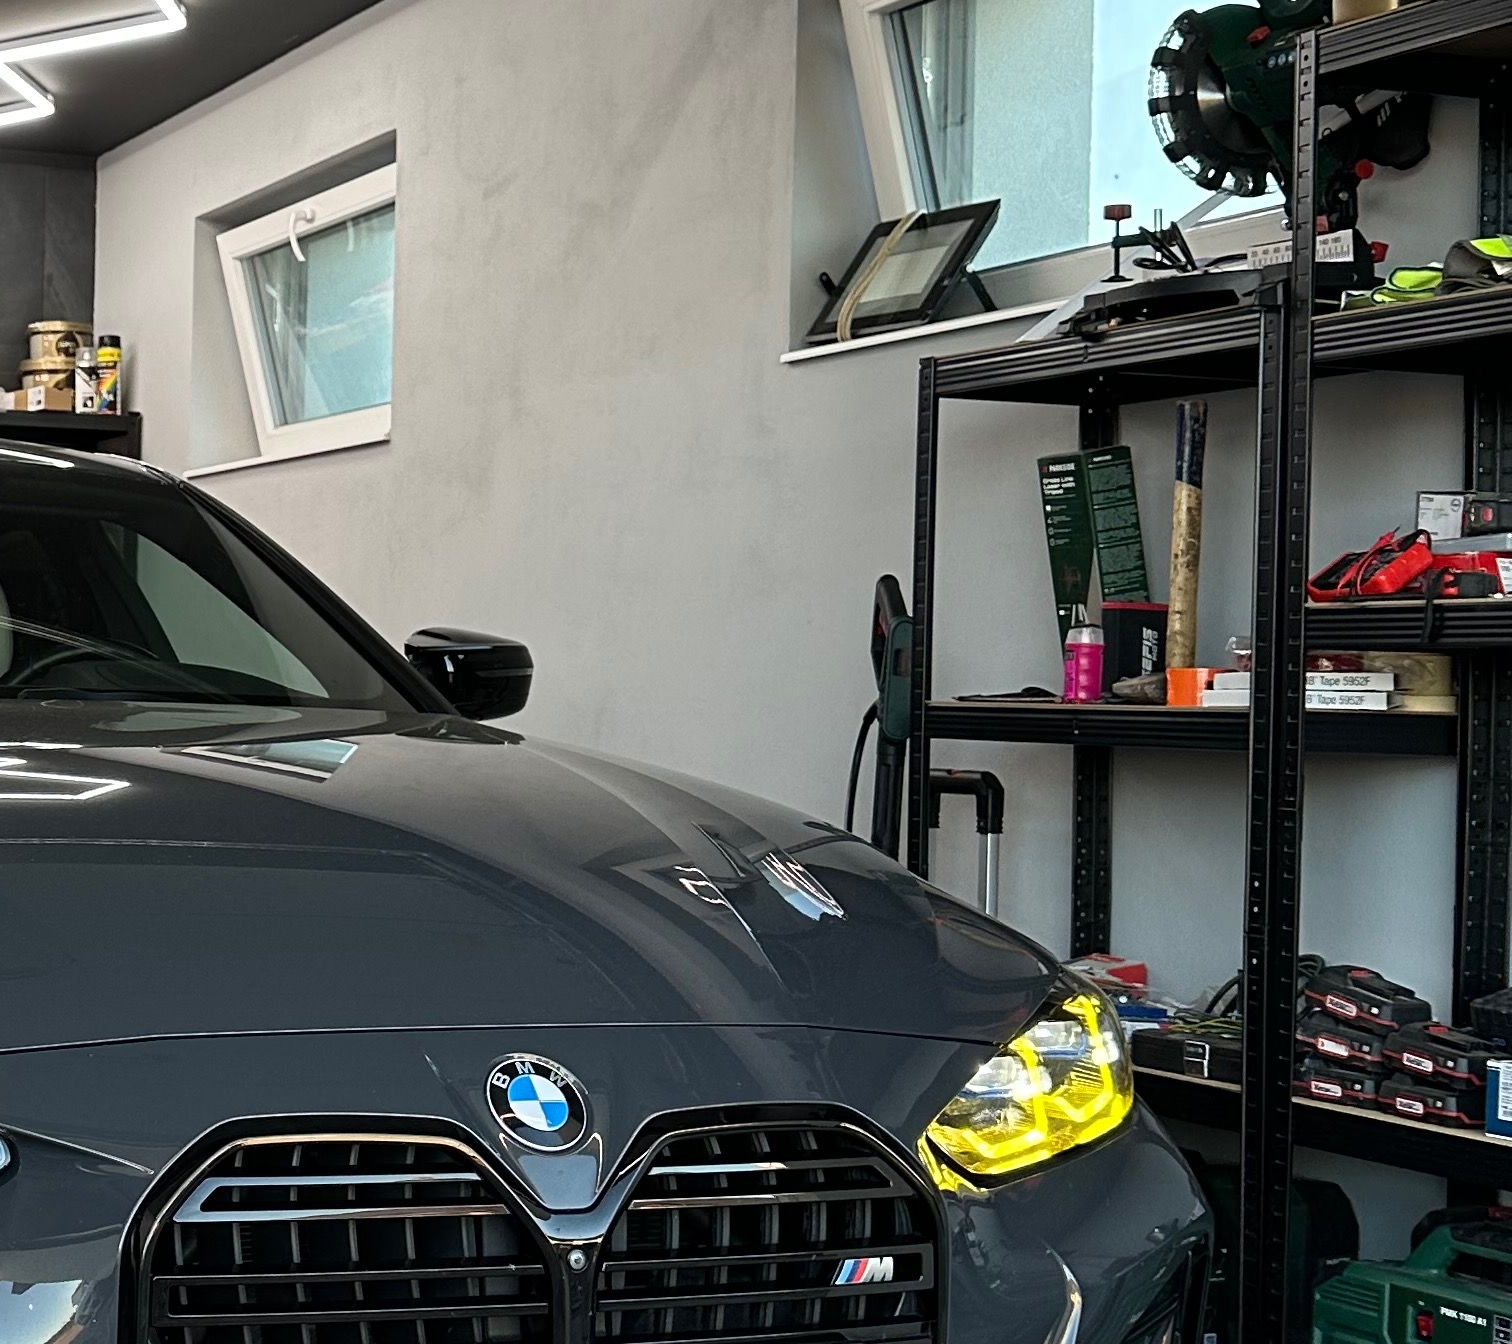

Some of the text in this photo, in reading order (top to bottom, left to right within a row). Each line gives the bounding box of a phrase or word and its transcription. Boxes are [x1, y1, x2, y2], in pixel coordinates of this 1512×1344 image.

[1320, 676, 1341, 687] Tape
[1317, 694, 1337, 705] Tape
[492, 1061, 567, 1089] BMW
